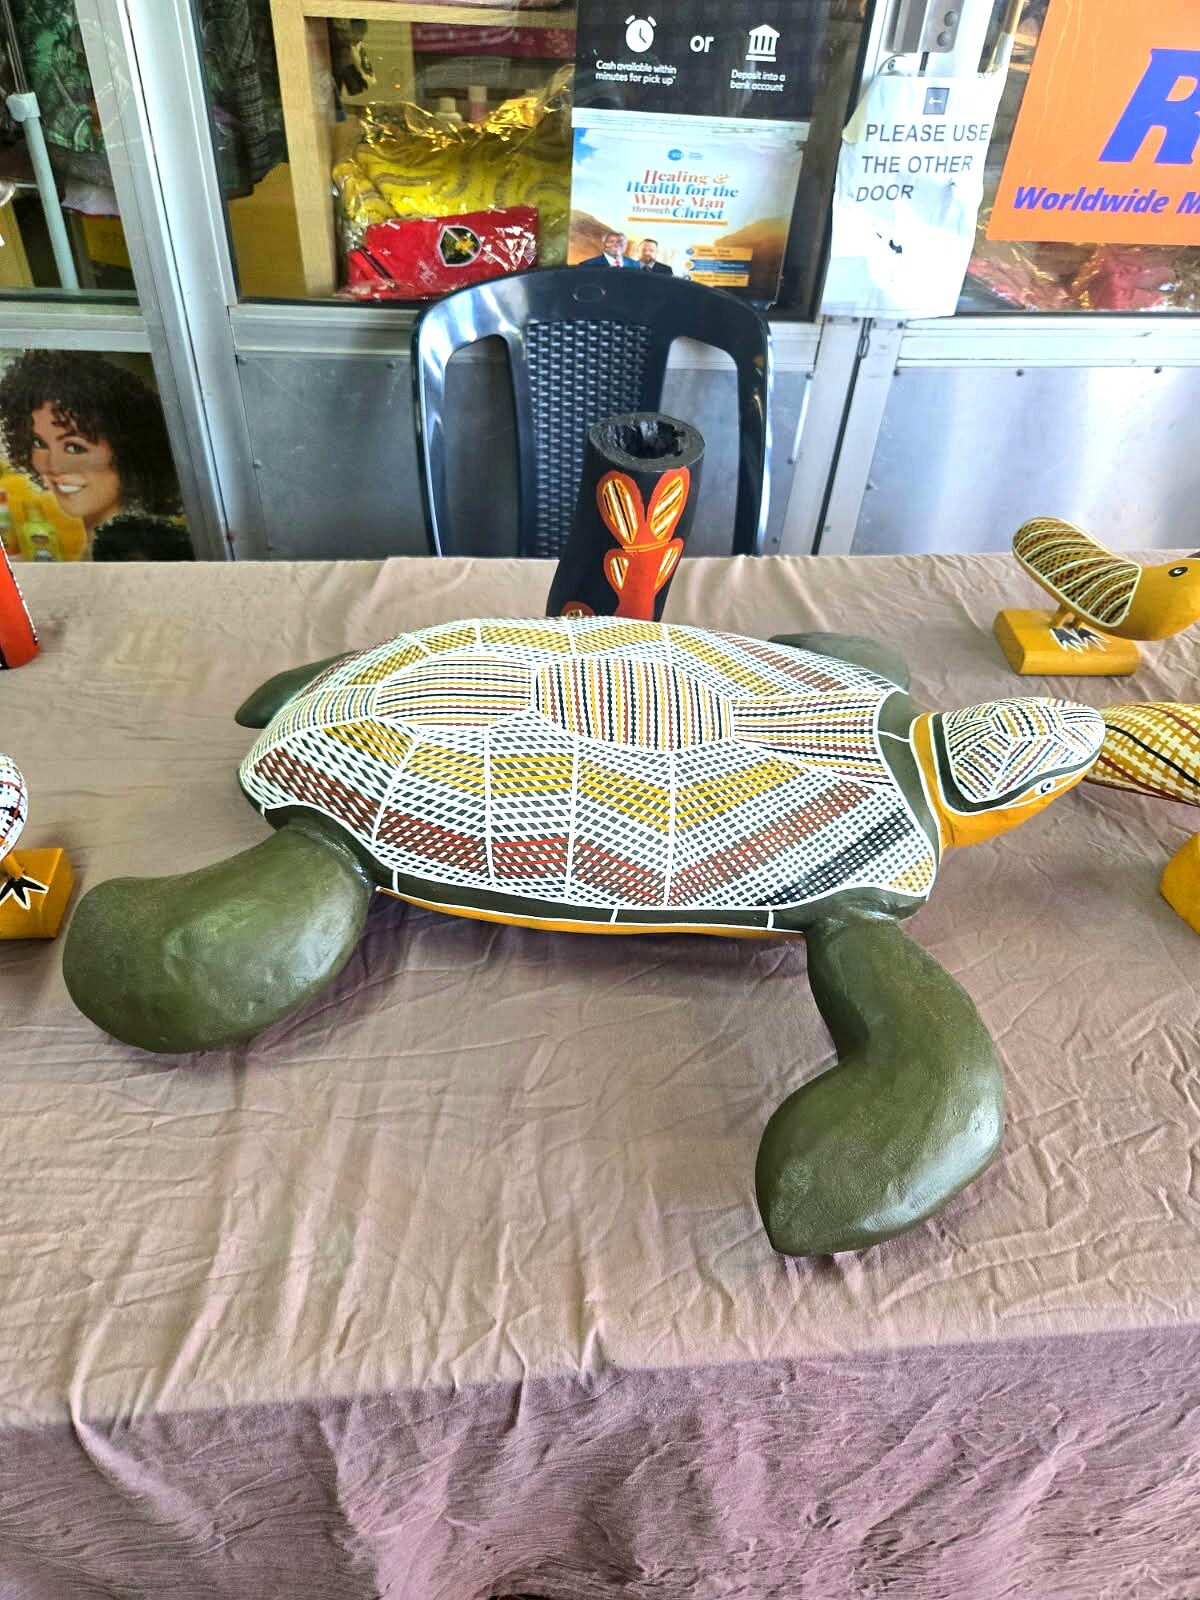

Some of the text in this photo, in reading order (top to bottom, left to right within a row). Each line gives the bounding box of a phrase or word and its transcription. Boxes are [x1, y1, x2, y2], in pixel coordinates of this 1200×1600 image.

[689, 35, 715, 53] or
[595, 60, 677, 74] Cash available within
[731, 69, 762, 80] Deposit
[762, 71, 779, 81] into
[595, 71, 628, 81] minutes
[629, 73, 641, 82] for
[642, 74, 660, 84] pick
[730, 80, 784, 92] bank account
[1098, 48, 1200, 165] R
[865, 124, 990, 142] PLEASE USE
[862, 156, 973, 173] THE OTHER
[644, 169, 709, 185] Healing
[626, 181, 739, 198] Health for the
[856, 184, 914, 202] DOOR
[633, 194, 725, 209] Whole Man
[1014, 186, 1169, 214] Worldwide
[672, 206, 723, 220] Christ
